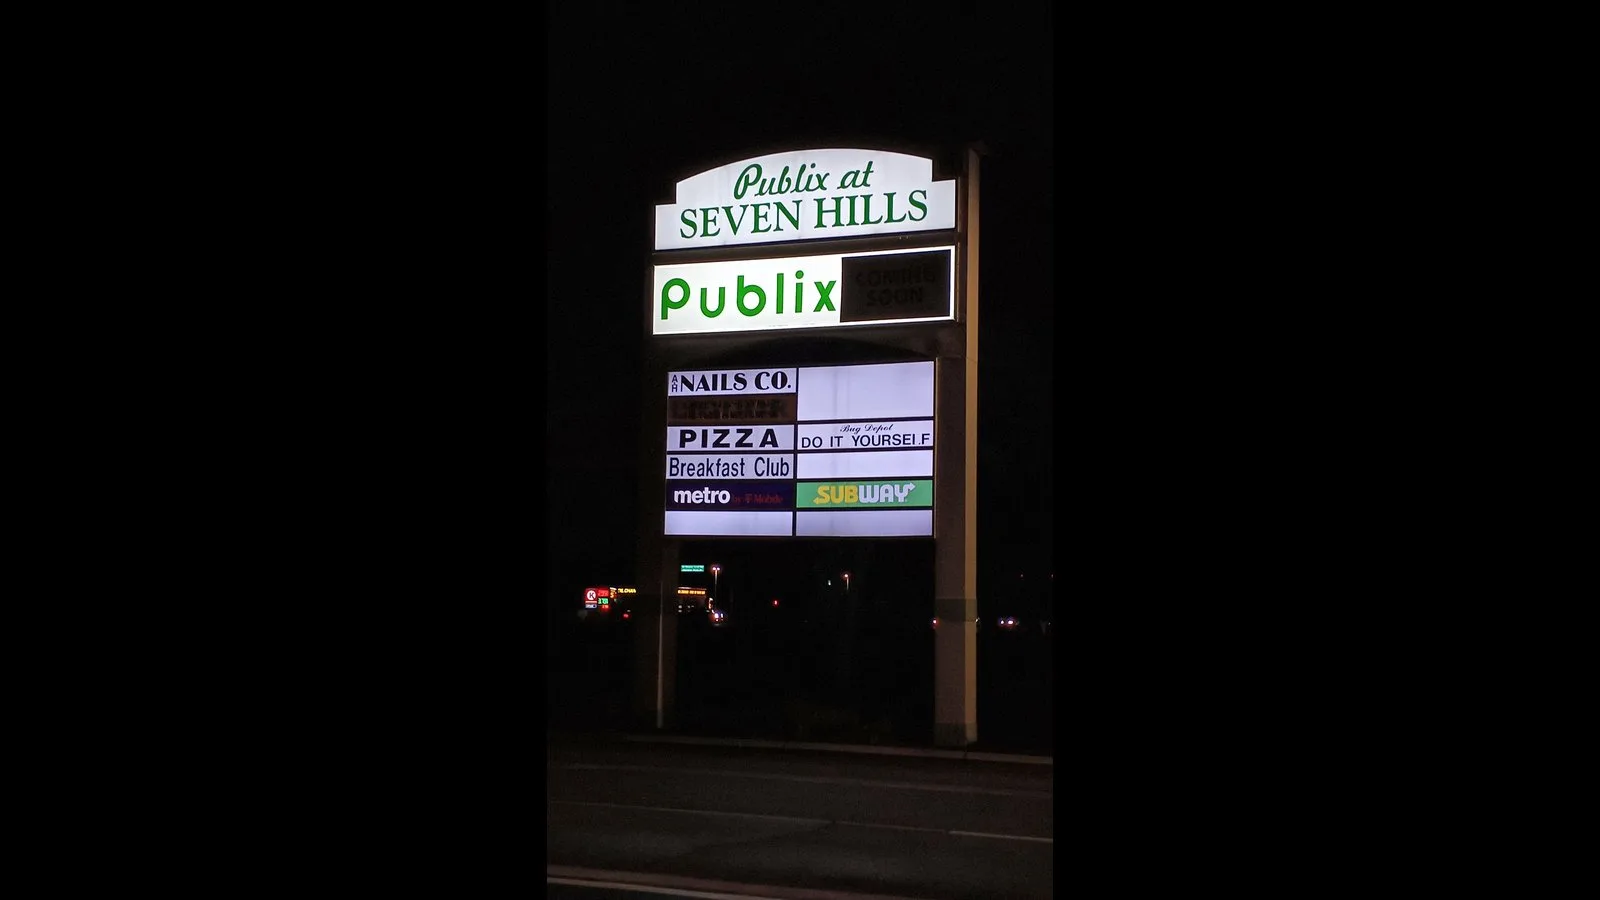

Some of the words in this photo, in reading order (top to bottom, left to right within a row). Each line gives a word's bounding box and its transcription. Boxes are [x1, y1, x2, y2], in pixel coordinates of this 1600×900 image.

[734, 162, 830, 200] Publix
[836, 160, 874, 190] at
[679, 200, 802, 239] SEVEN
[814, 189, 929, 230] HILLS
[660, 269, 837, 321] Publix
[681, 373, 747, 393] NAILS
[755, 371, 792, 391] CO.
[679, 428, 779, 449] PIZZA
[840, 424, 861, 435] Bug
[864, 423, 894, 434] Depot
[801, 436, 823, 449] DO
[830, 435, 844, 448] IT
[669, 457, 745, 478] Breakfast
[754, 456, 790, 477] Club
[674, 487, 731, 504] metro
[813, 482, 916, 505] SUBWAY
